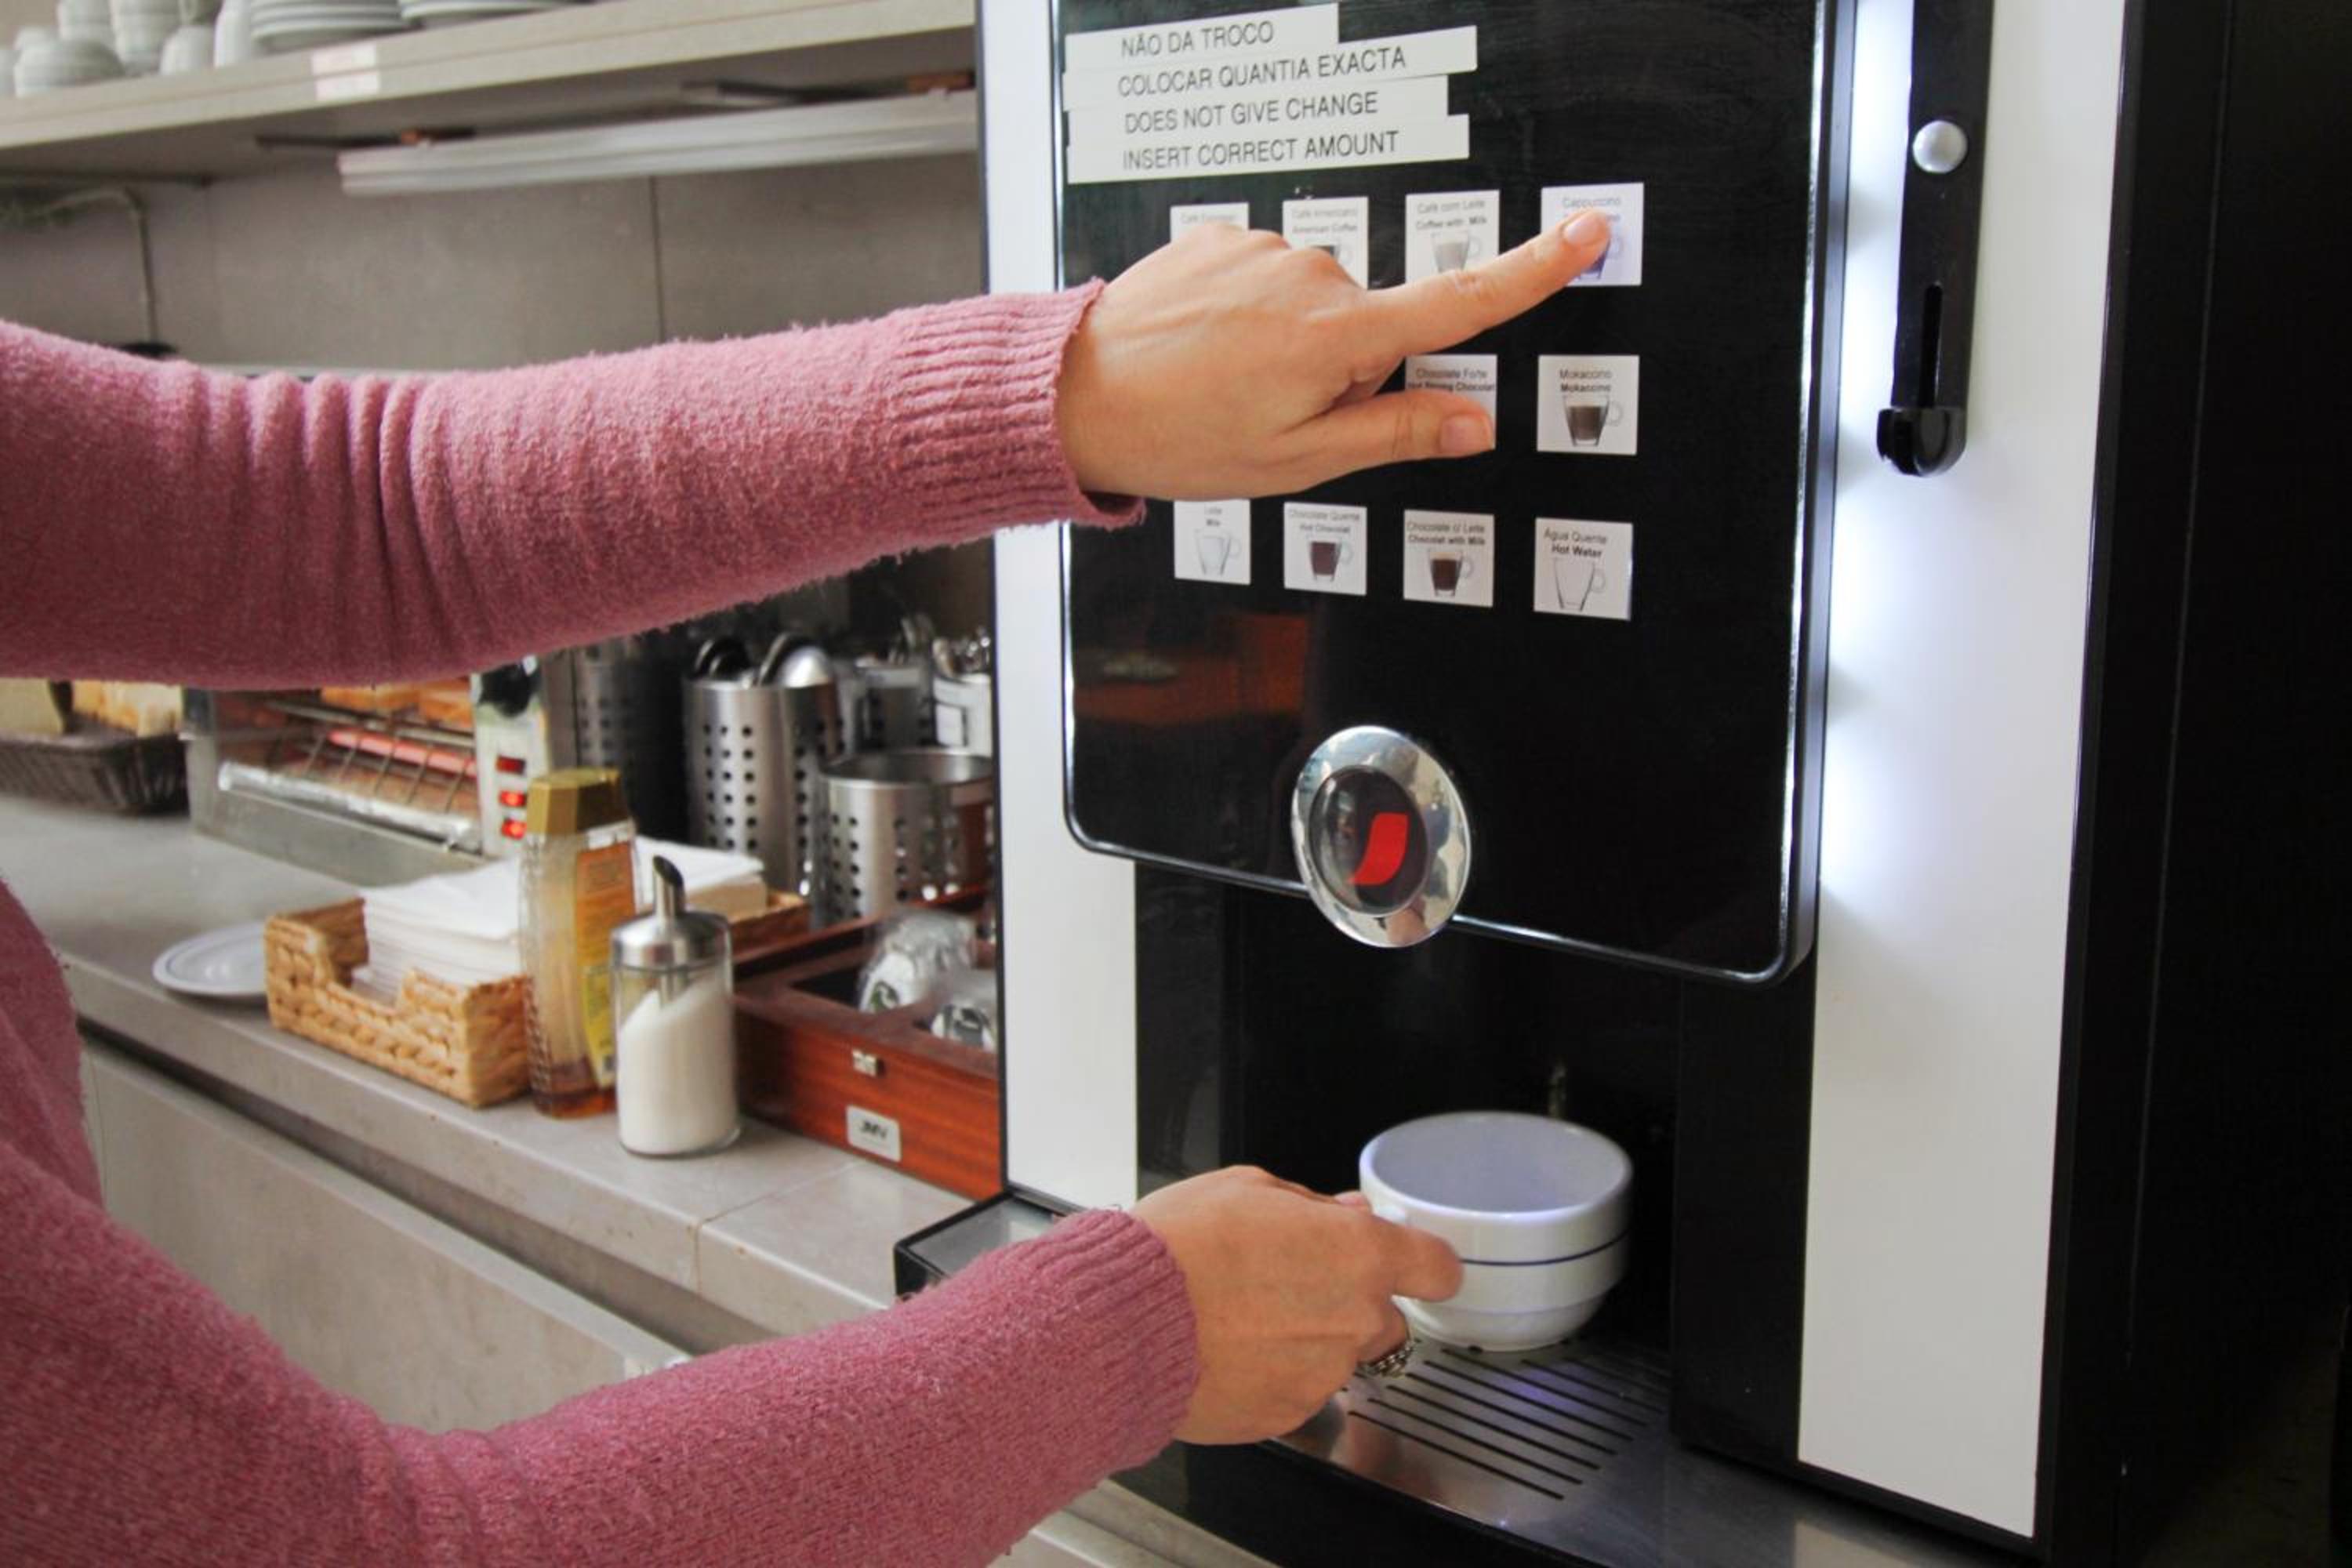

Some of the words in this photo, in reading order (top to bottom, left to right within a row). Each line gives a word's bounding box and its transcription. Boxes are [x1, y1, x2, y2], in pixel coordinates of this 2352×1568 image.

[1122, 32, 1161, 56] NÃO
[1168, 31, 1194, 53] DA
[1201, 20, 1274, 49] TROCO
[1118, 67, 1212, 96] COLOCAR
[1219, 57, 1310, 87] QUANTIA
[1318, 45, 1406, 78] EXACTA
[1125, 108, 1178, 134] DOES
[1184, 104, 1225, 129] NOT
[1231, 100, 1279, 125] GIVE
[1286, 91, 1378, 120] CHANGE
[1123, 146, 1192, 170] INSERT
[1198, 138, 1298, 166] CORRECT
[1305, 130, 1399, 158] AMOUNT
[1416, 220, 1443, 230] Coffee
[1468, 216, 1487, 226] Milk
[1447, 535, 1465, 545] with
[1467, 535, 1486, 546] Milk
[1552, 543, 1570, 555] Hot
[1572, 544, 1602, 558] Water
[1571, 531, 1607, 546] Quente
